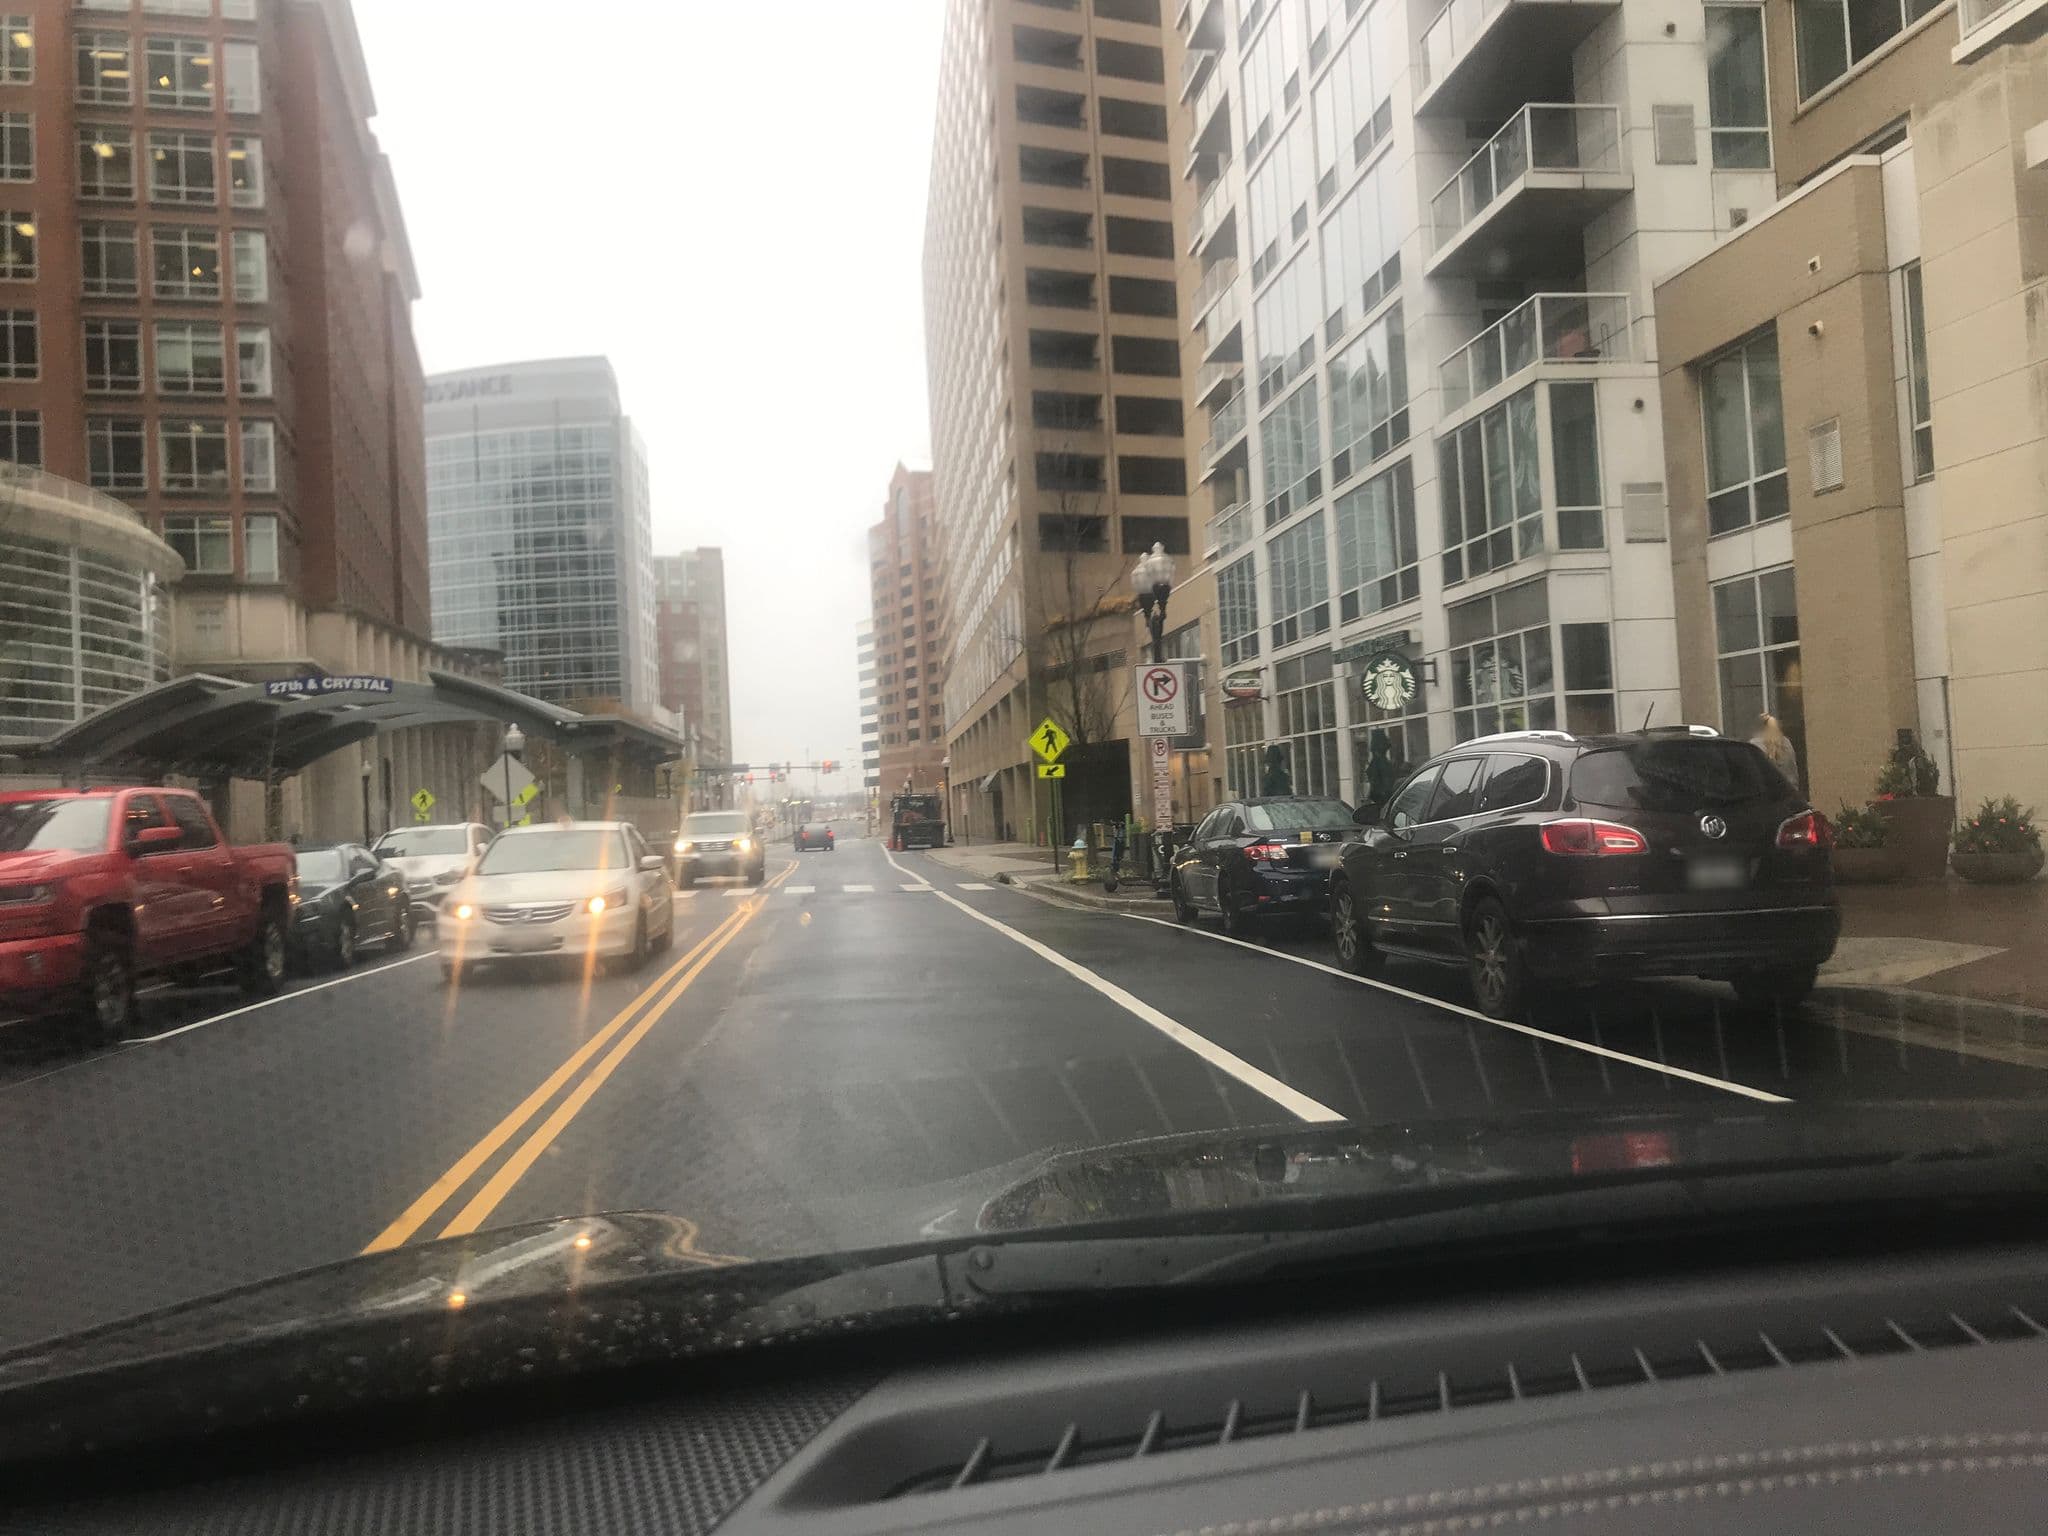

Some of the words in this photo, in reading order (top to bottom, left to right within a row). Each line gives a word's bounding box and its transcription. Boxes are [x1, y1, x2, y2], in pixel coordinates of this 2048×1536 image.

[270, 680, 303, 694] 27th
[307, 678, 319, 690] &
[322, 678, 389, 691] CRYSTAL
[1151, 712, 1174, 720] BUSES
